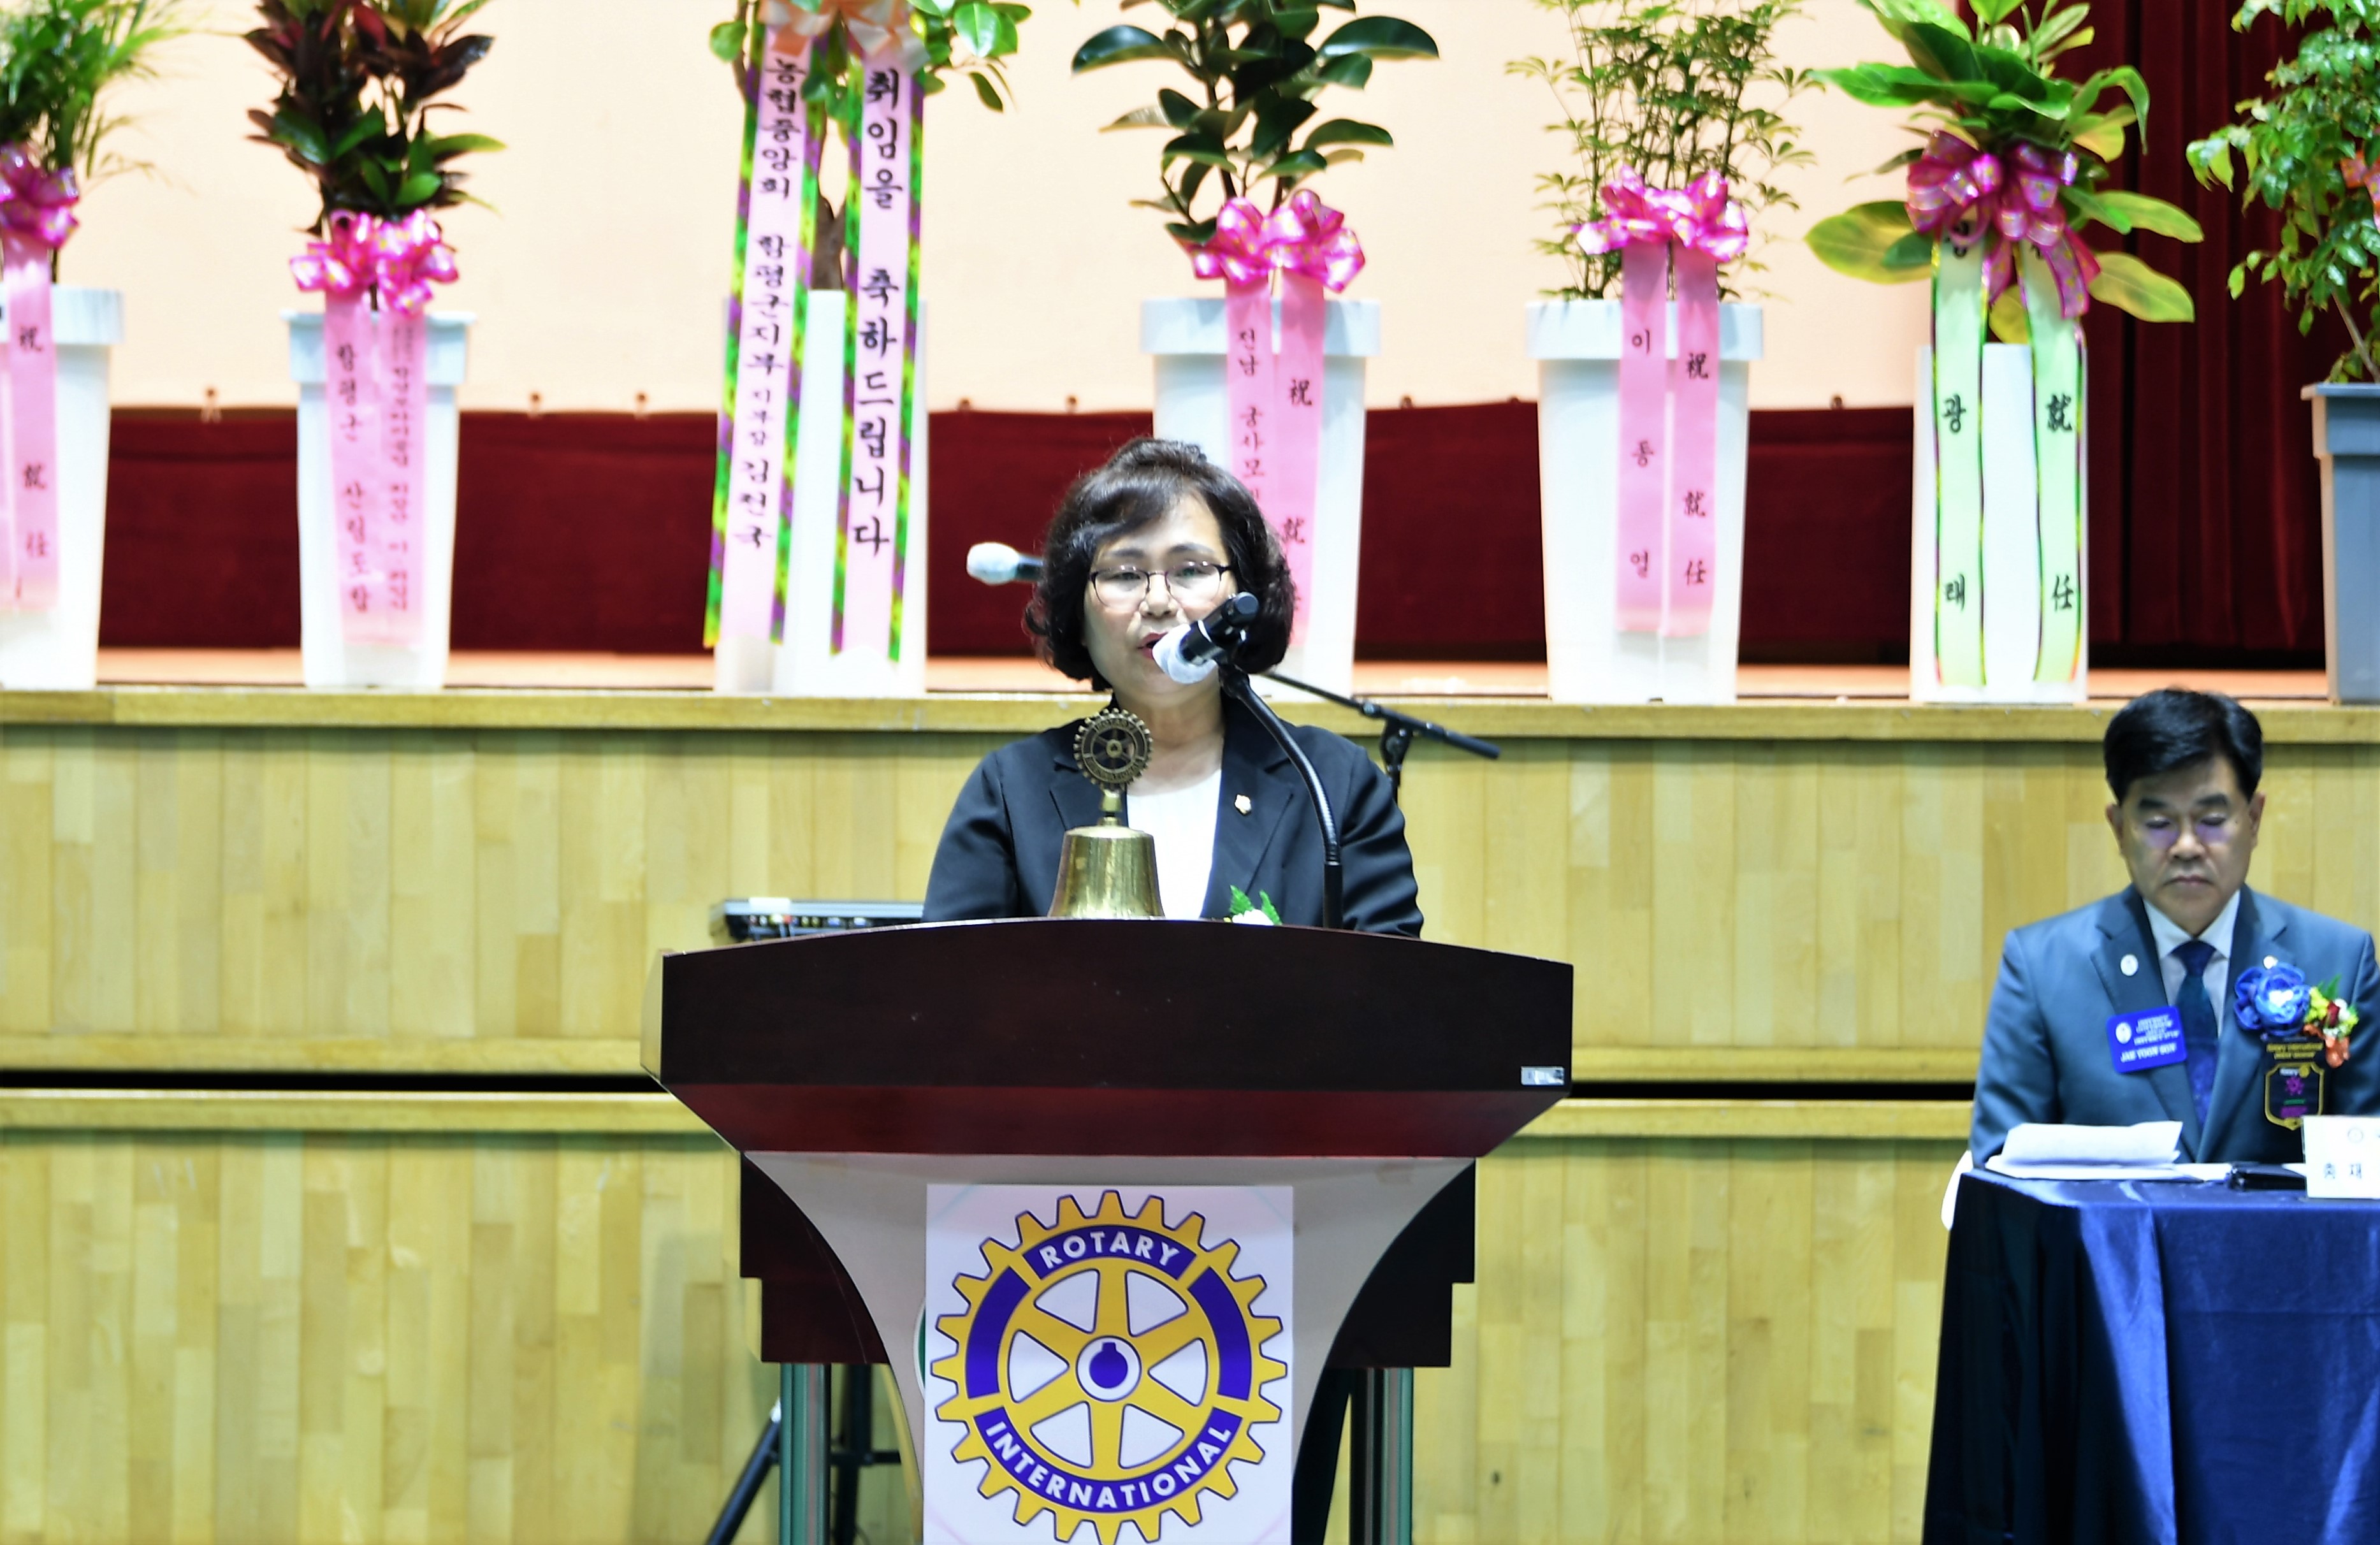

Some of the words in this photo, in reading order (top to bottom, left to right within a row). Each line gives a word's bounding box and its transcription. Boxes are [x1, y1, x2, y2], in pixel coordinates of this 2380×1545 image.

[865, 67, 903, 208] 취임을
[1289, 379, 1312, 405] 祝
[1686, 352, 1709, 379] 祝
[853, 268, 900, 556] 축하드립니다
[1683, 491, 1707, 586] 就任
[1038, 1230, 1180, 1269] ROTARY
[985, 1421, 1232, 1511] INTERNATIONAL
